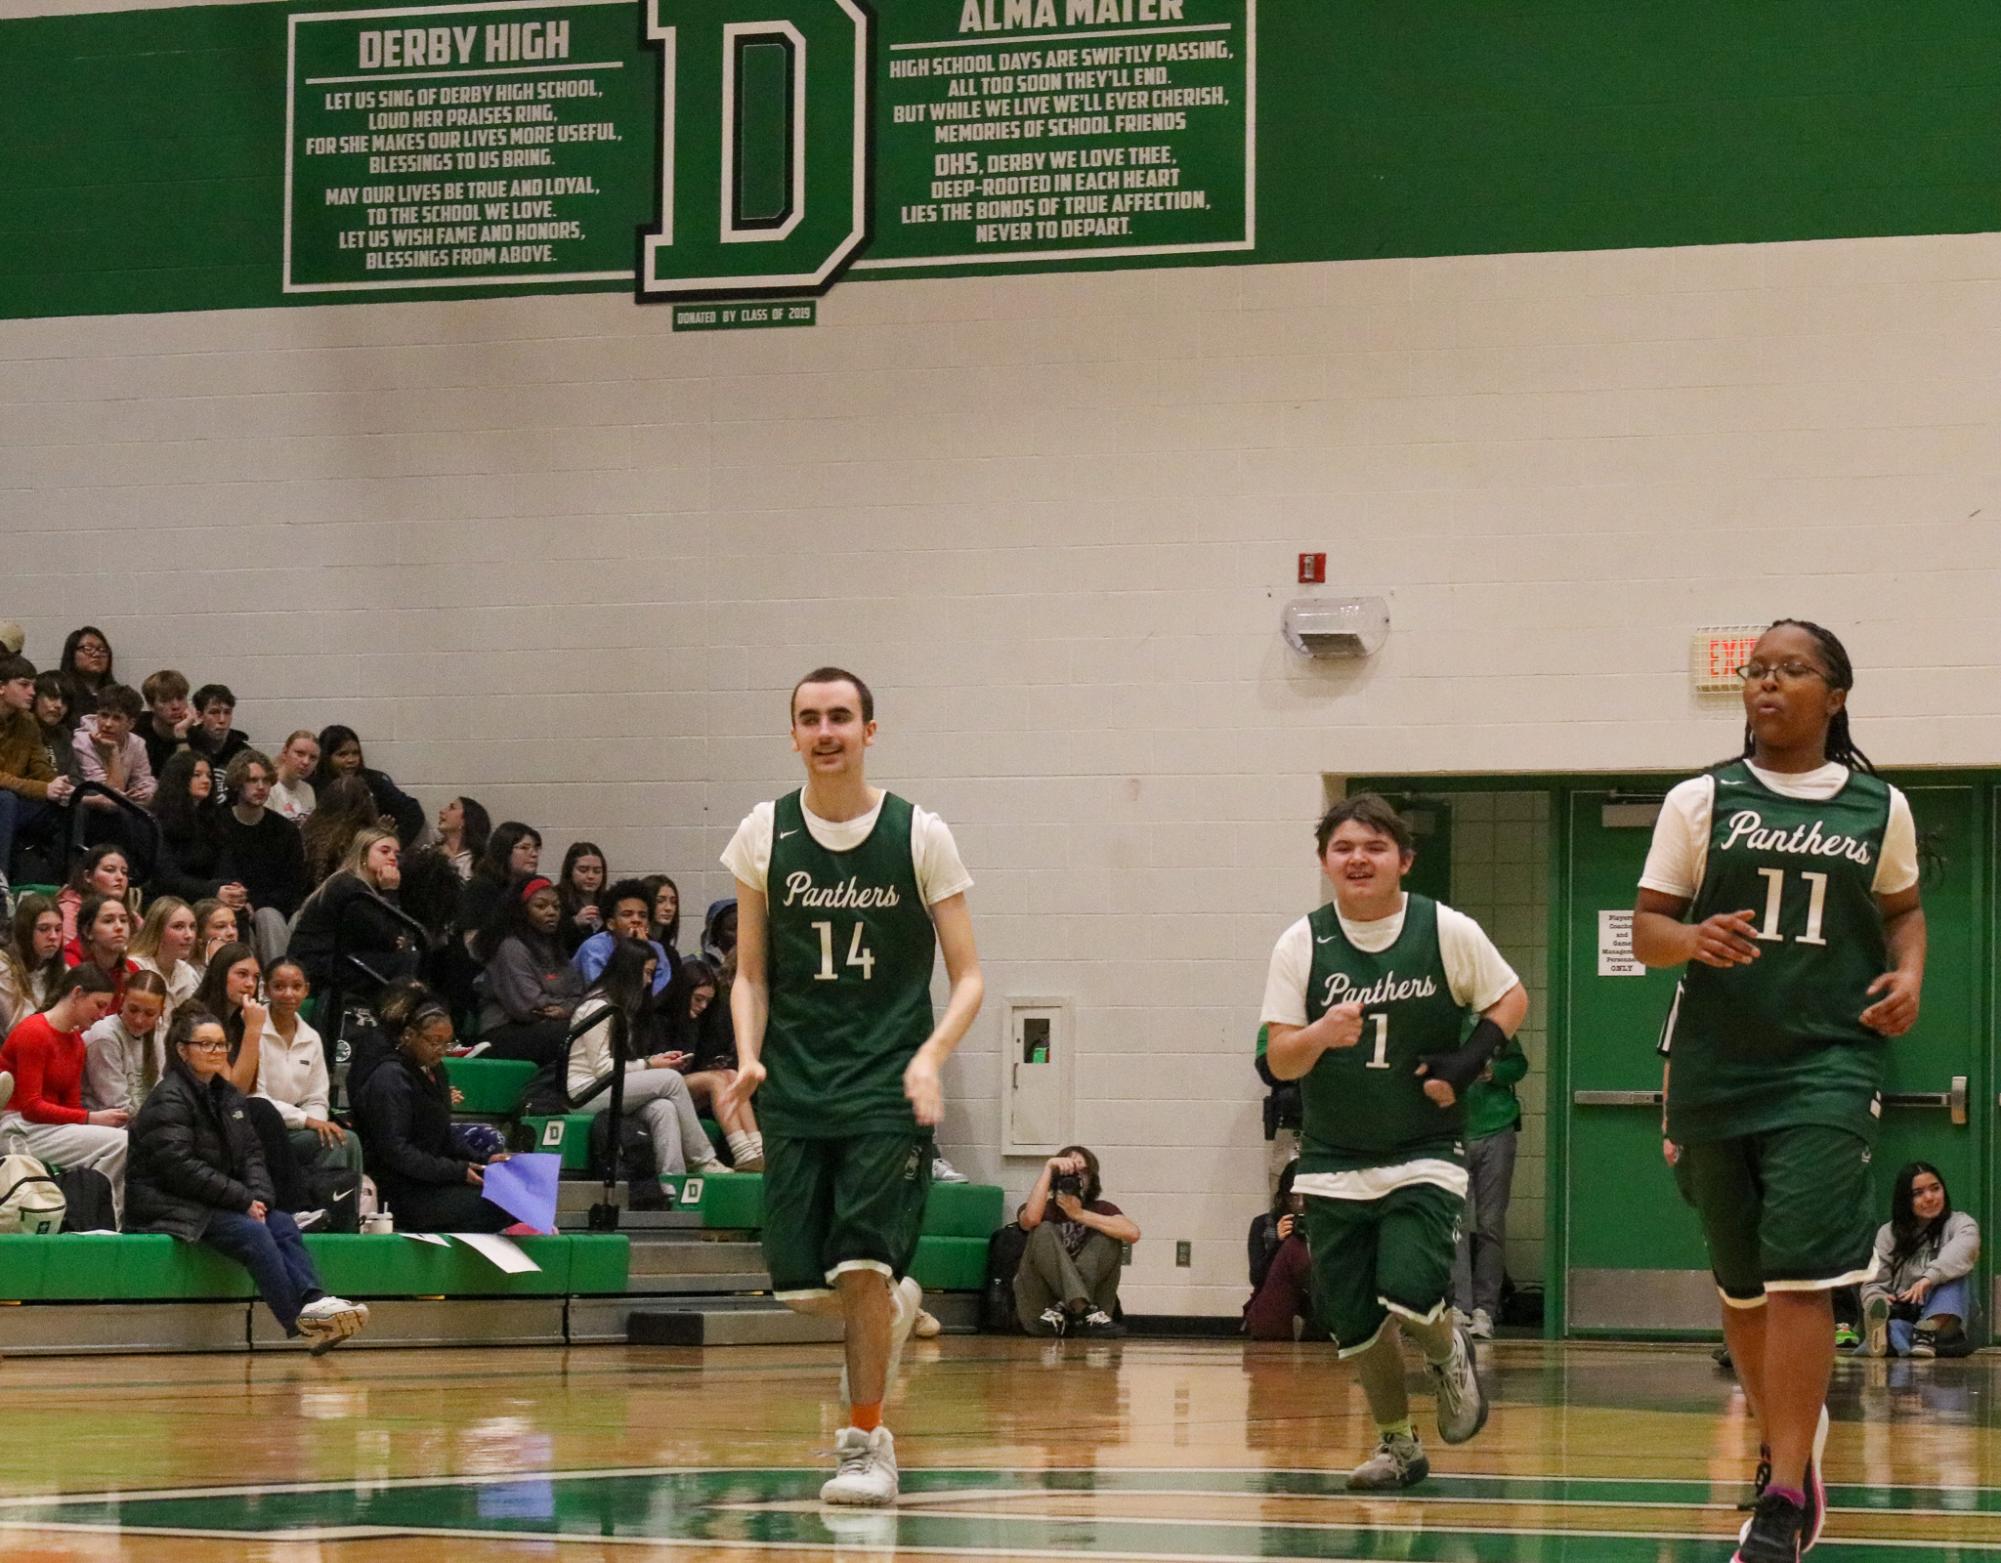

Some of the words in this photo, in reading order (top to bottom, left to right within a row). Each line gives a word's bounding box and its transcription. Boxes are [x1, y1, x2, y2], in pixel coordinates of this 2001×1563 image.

[958, 0, 1057, 33] ALMA
[359, 25, 477, 69] DERBY
[485, 19, 570, 63] HIGH
[889, 58, 930, 79] HIGH
[932, 54, 995, 76] SCHOOL
[998, 51, 1043, 72] DAYS
[1045, 48, 1078, 69] ARE
[1081, 44, 1153, 67] SWIFTLY
[1155, 39, 1234, 62] PASSING,
[325, 92, 351, 110] LET
[354, 91, 376, 110] US
[378, 89, 415, 108] SING
[417, 87, 437, 106] OF
[439, 85, 493, 105] DERBY
[495, 82, 535, 102] HIGH
[537, 79, 603, 100] SCHOOL,
[947, 78, 977, 97] ALL
[981, 75, 1014, 95] TOO
[1016, 72, 1062, 93] SOON
[1065, 68, 1131, 90] THEY'LL
[1133, 66, 1172, 86] END.
[368, 111, 410, 131] LOUD
[412, 109, 444, 128] HER
[446, 105, 513, 127] PRAISES
[514, 103, 558, 123] RING,
[893, 103, 926, 123] BUT
[929, 100, 982, 121] WHILE
[984, 98, 1011, 118] WE
[1013, 95, 1050, 116] LIVE
[1052, 93, 1102, 114] WE'LL
[1105, 90, 1149, 111] EVER
[1151, 85, 1230, 108] CHERISH,
[305, 136, 337, 155] FOR
[339, 135, 369, 154] SHE
[371, 132, 425, 152] MAKES
[427, 130, 461, 150] OUR
[463, 128, 507, 148] LIVES
[509, 125, 555, 145] MORE
[557, 122, 622, 143] USEFUL,
[934, 120, 1021, 144] MEMORIES
[1023, 119, 1045, 139] OF
[1047, 115, 1112, 137] SCHOOL
[1114, 111, 1187, 133] FRIENDS
[369, 153, 453, 174] BLESSINGS
[456, 151, 477, 170] TO
[478, 150, 500, 169] US
[501, 148, 556, 168] BRING.
[638, 0, 873, 297] D
[934, 151, 983, 177] DHS,
[987, 152, 1046, 174] DERBY
[1049, 150, 1077, 169] WE
[1080, 147, 1125, 168] LOVE
[1129, 145, 1177, 166] THEE,
[325, 187, 359, 206] MAY
[362, 185, 395, 204] OUR
[397, 183, 442, 203] LIVES
[443, 182, 464, 200] BE
[467, 180, 507, 199] TRUE
[510, 178, 543, 198] AND
[545, 176, 600, 196] LOYAL,
[931, 174, 1052, 199] DEEP-ROOTED
[1053, 173, 1073, 193] IN
[1074, 170, 1120, 192] EACH
[1122, 167, 1181, 189] HEART
[367, 207, 388, 226] TO
[391, 206, 419, 225] THE
[422, 204, 481, 223] SCHOOL
[484, 202, 510, 221] WE
[512, 200, 557, 220] LOVE.
[901, 204, 938, 225] LIES
[941, 202, 973, 222] THE
[975, 198, 1035, 220] BONDS
[1037, 197, 1060, 217] OF
[1064, 194, 1108, 215] TRUE
[1111, 190, 1211, 213] AFFECTION,
[339, 230, 365, 249] LET
[368, 229, 389, 248] US
[392, 227, 434, 247] WISH
[436, 225, 477, 245] FAME
[480, 223, 513, 243] AND
[515, 220, 586, 241] HONORS,
[975, 222, 1033, 243] NEVER
[1036, 220, 1059, 240] TO
[1061, 216, 1133, 238] DEPART.
[366, 249, 449, 270] BLESSINGS
[452, 247, 497, 266] FROM
[499, 244, 557, 264] ABOVE.
[1721, 810, 1871, 865] Panthers
[783, 870, 900, 908] Panthers
[1756, 867, 1828, 946] 11
[811, 921, 876, 981] 14
[1320, 970, 1437, 1007] Panthers
[1365, 1013, 1391, 1069] 1
